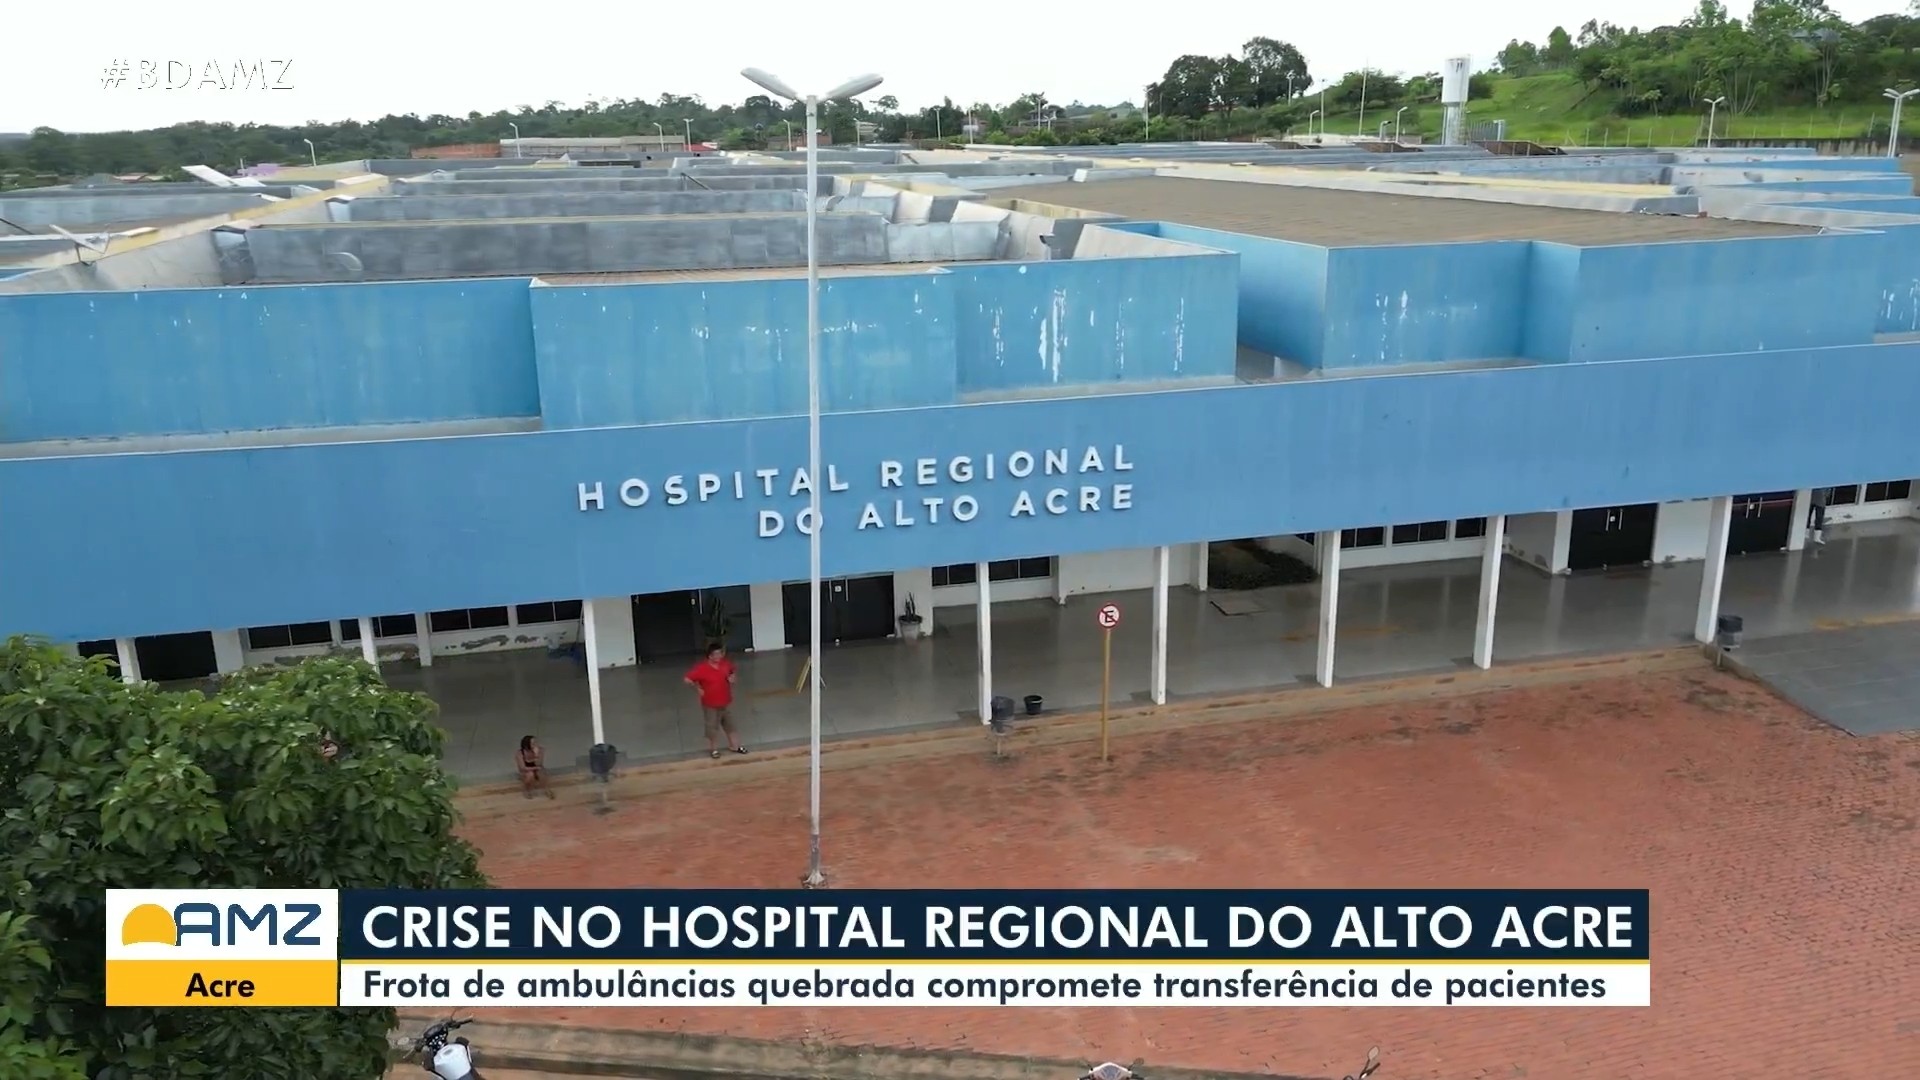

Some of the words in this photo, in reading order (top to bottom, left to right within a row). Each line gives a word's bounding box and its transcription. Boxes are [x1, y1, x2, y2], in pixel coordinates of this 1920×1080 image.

[578, 464, 849, 511] HOSPITAL
[881, 444, 1133, 487] REGIONAL
[759, 507, 823, 537] DO
[858, 494, 979, 530] ALTO
[1010, 484, 1133, 517] ACRE
